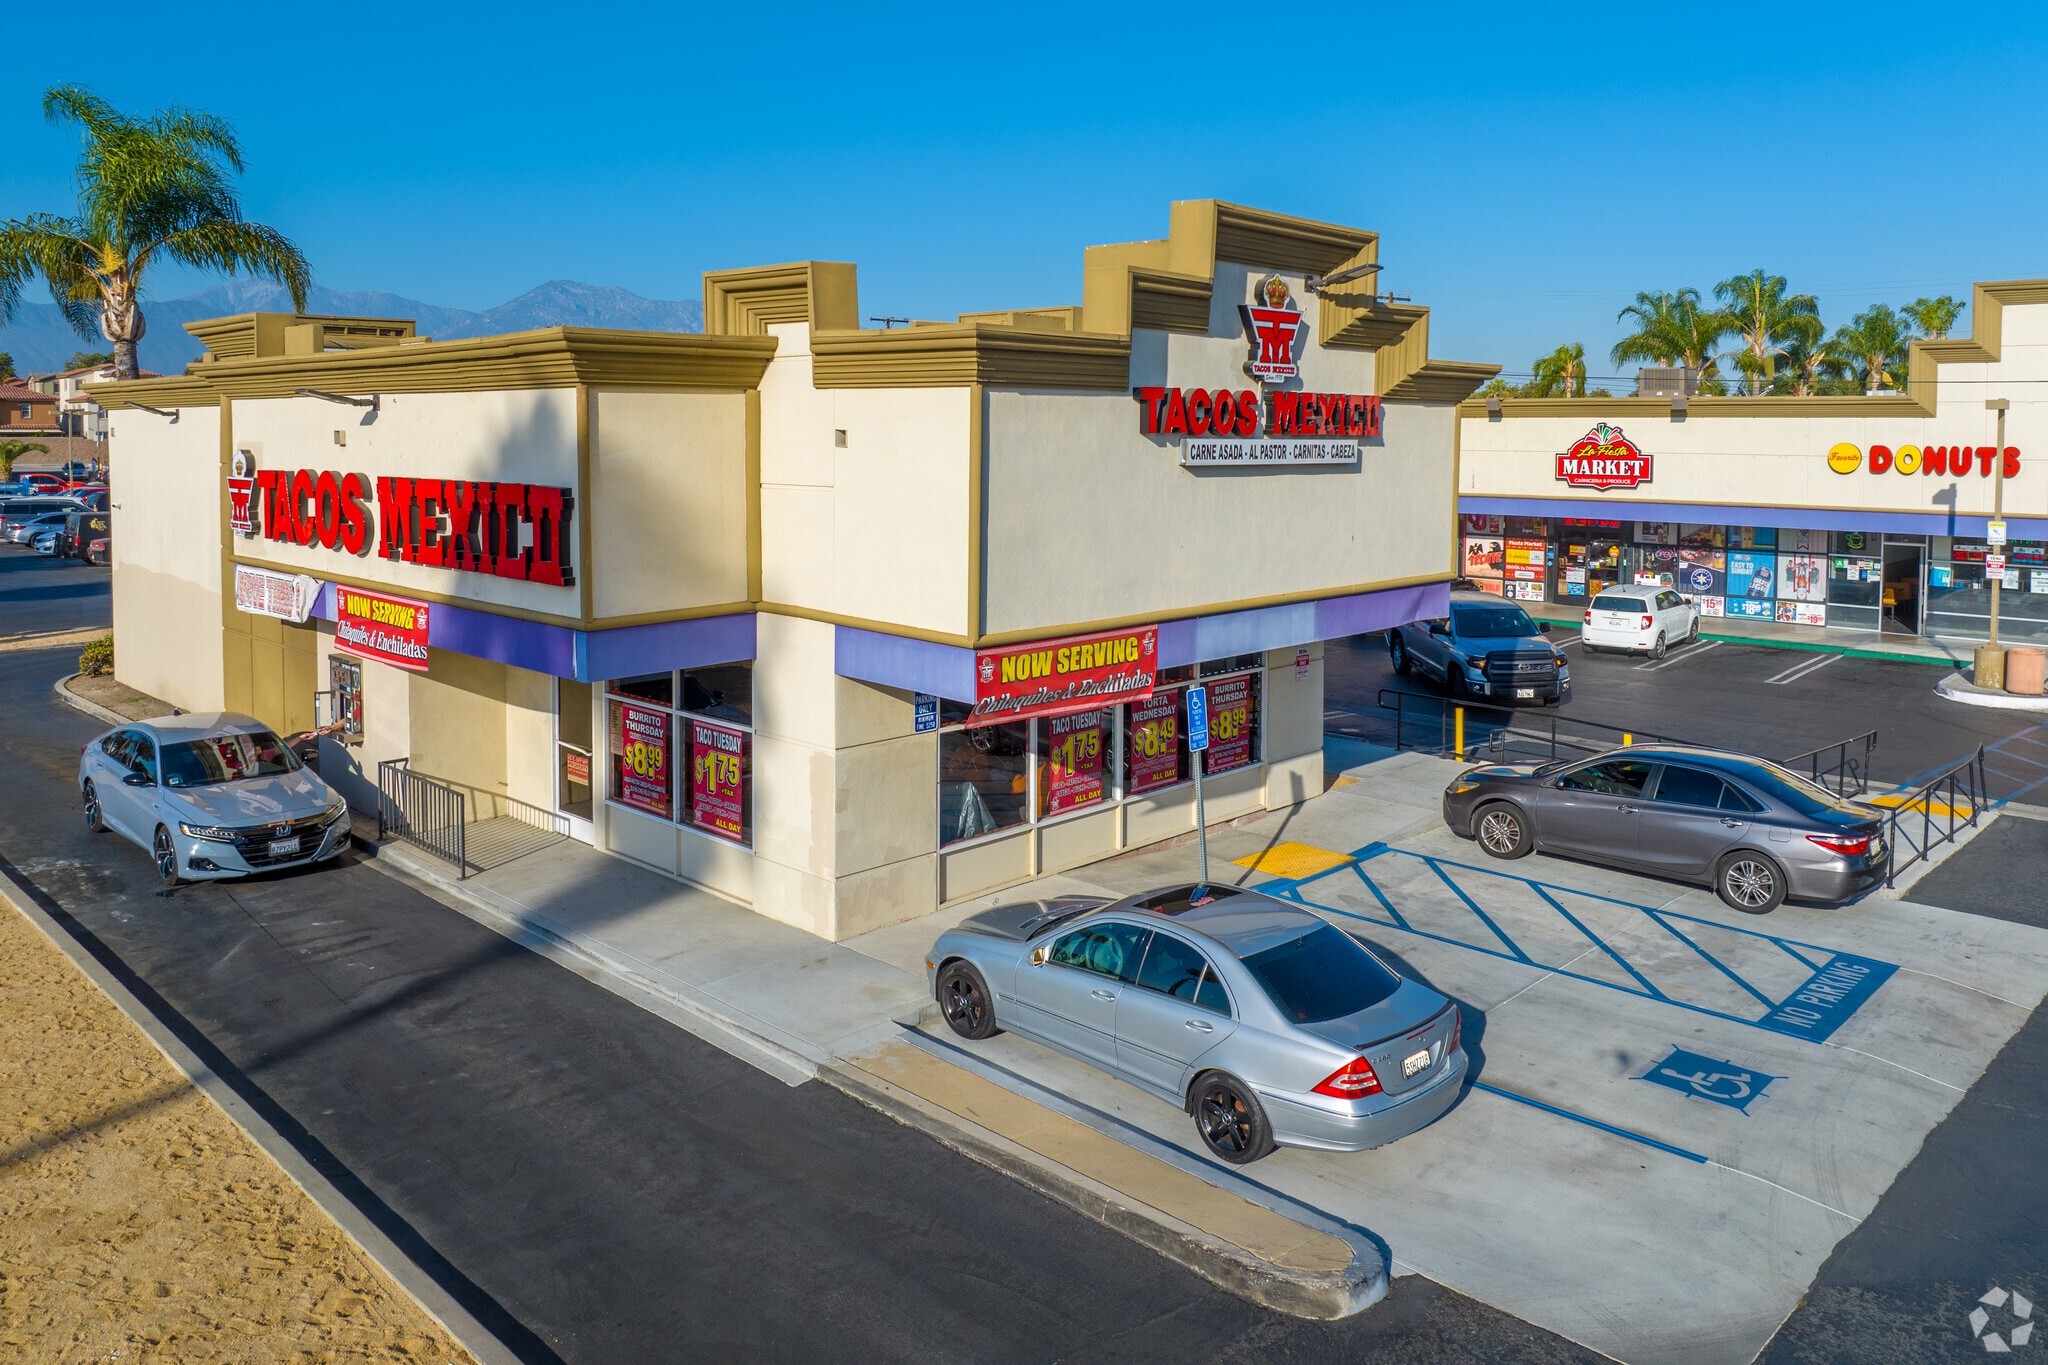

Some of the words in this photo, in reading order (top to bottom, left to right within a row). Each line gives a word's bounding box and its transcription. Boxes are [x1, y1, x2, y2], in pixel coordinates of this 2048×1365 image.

[1254, 365, 1271, 373] TACOS
[1141, 386, 1259, 437] TACOS
[1272, 390, 1382, 437] MEXICO
[1190, 444, 1216, 460] CARNE
[1218, 444, 1243, 460] ASADA
[1249, 444, 1259, 460] AL
[1260, 444, 1287, 460] PASTOR
[1293, 444, 1326, 459] CARNITAS
[1330, 443, 1356, 459] CABEZA
[1577, 444, 1597, 457] La
[1597, 444, 1629, 457] Fiesta
[1829, 452, 1860, 462] Favorite
[1562, 458, 1644, 476] MARKET
[1869, 445, 2021, 479] DONUTS
[257, 469, 366, 555] TACOS
[377, 476, 567, 587] MEXICO
[1468, 551, 1503, 566] TECATE
[347, 594, 371, 619] NOW
[371, 599, 416, 631] SERVING
[337, 619, 369, 647] Chilaquiles
[368, 629, 377, 649] &
[376, 631, 428, 660] Enchiladas
[1001, 649, 1053, 684] NOW
[1056, 636, 1139, 675] SERVING
[974, 687, 1062, 717] Chilaquiles
[1062, 682, 1076, 700] &
[1076, 668, 1153, 699] Enchiladas
[1214, 681, 1246, 695] BURRITO
[1142, 695, 1168, 709] TORTA
[1211, 690, 1248, 705] THURSDAY
[918, 703, 933, 714] ONLY
[1132, 704, 1176, 722] WEDNESDAY
[629, 710, 661, 727] BURRITO
[916, 723, 925, 731] FINE
[1052, 716, 1070, 735] TACO
[1071, 710, 1101, 730] TUESDAY
[625, 720, 664, 738] THURSDAY
[695, 726, 713, 746] TACO
[713, 731, 742, 754] TUESDAY
[1152, 773, 1163, 781] ALL
[1164, 768, 1176, 777] DAY
[721, 788, 735, 797] +TAX
[1074, 795, 1087, 804] ALL
[1088, 789, 1101, 798] DAY
[715, 818, 728, 829] ALL
[728, 822, 741, 833] DAY
[1795, 961, 1871, 1009] PARKING
[1773, 1006, 1823, 1029] NO
